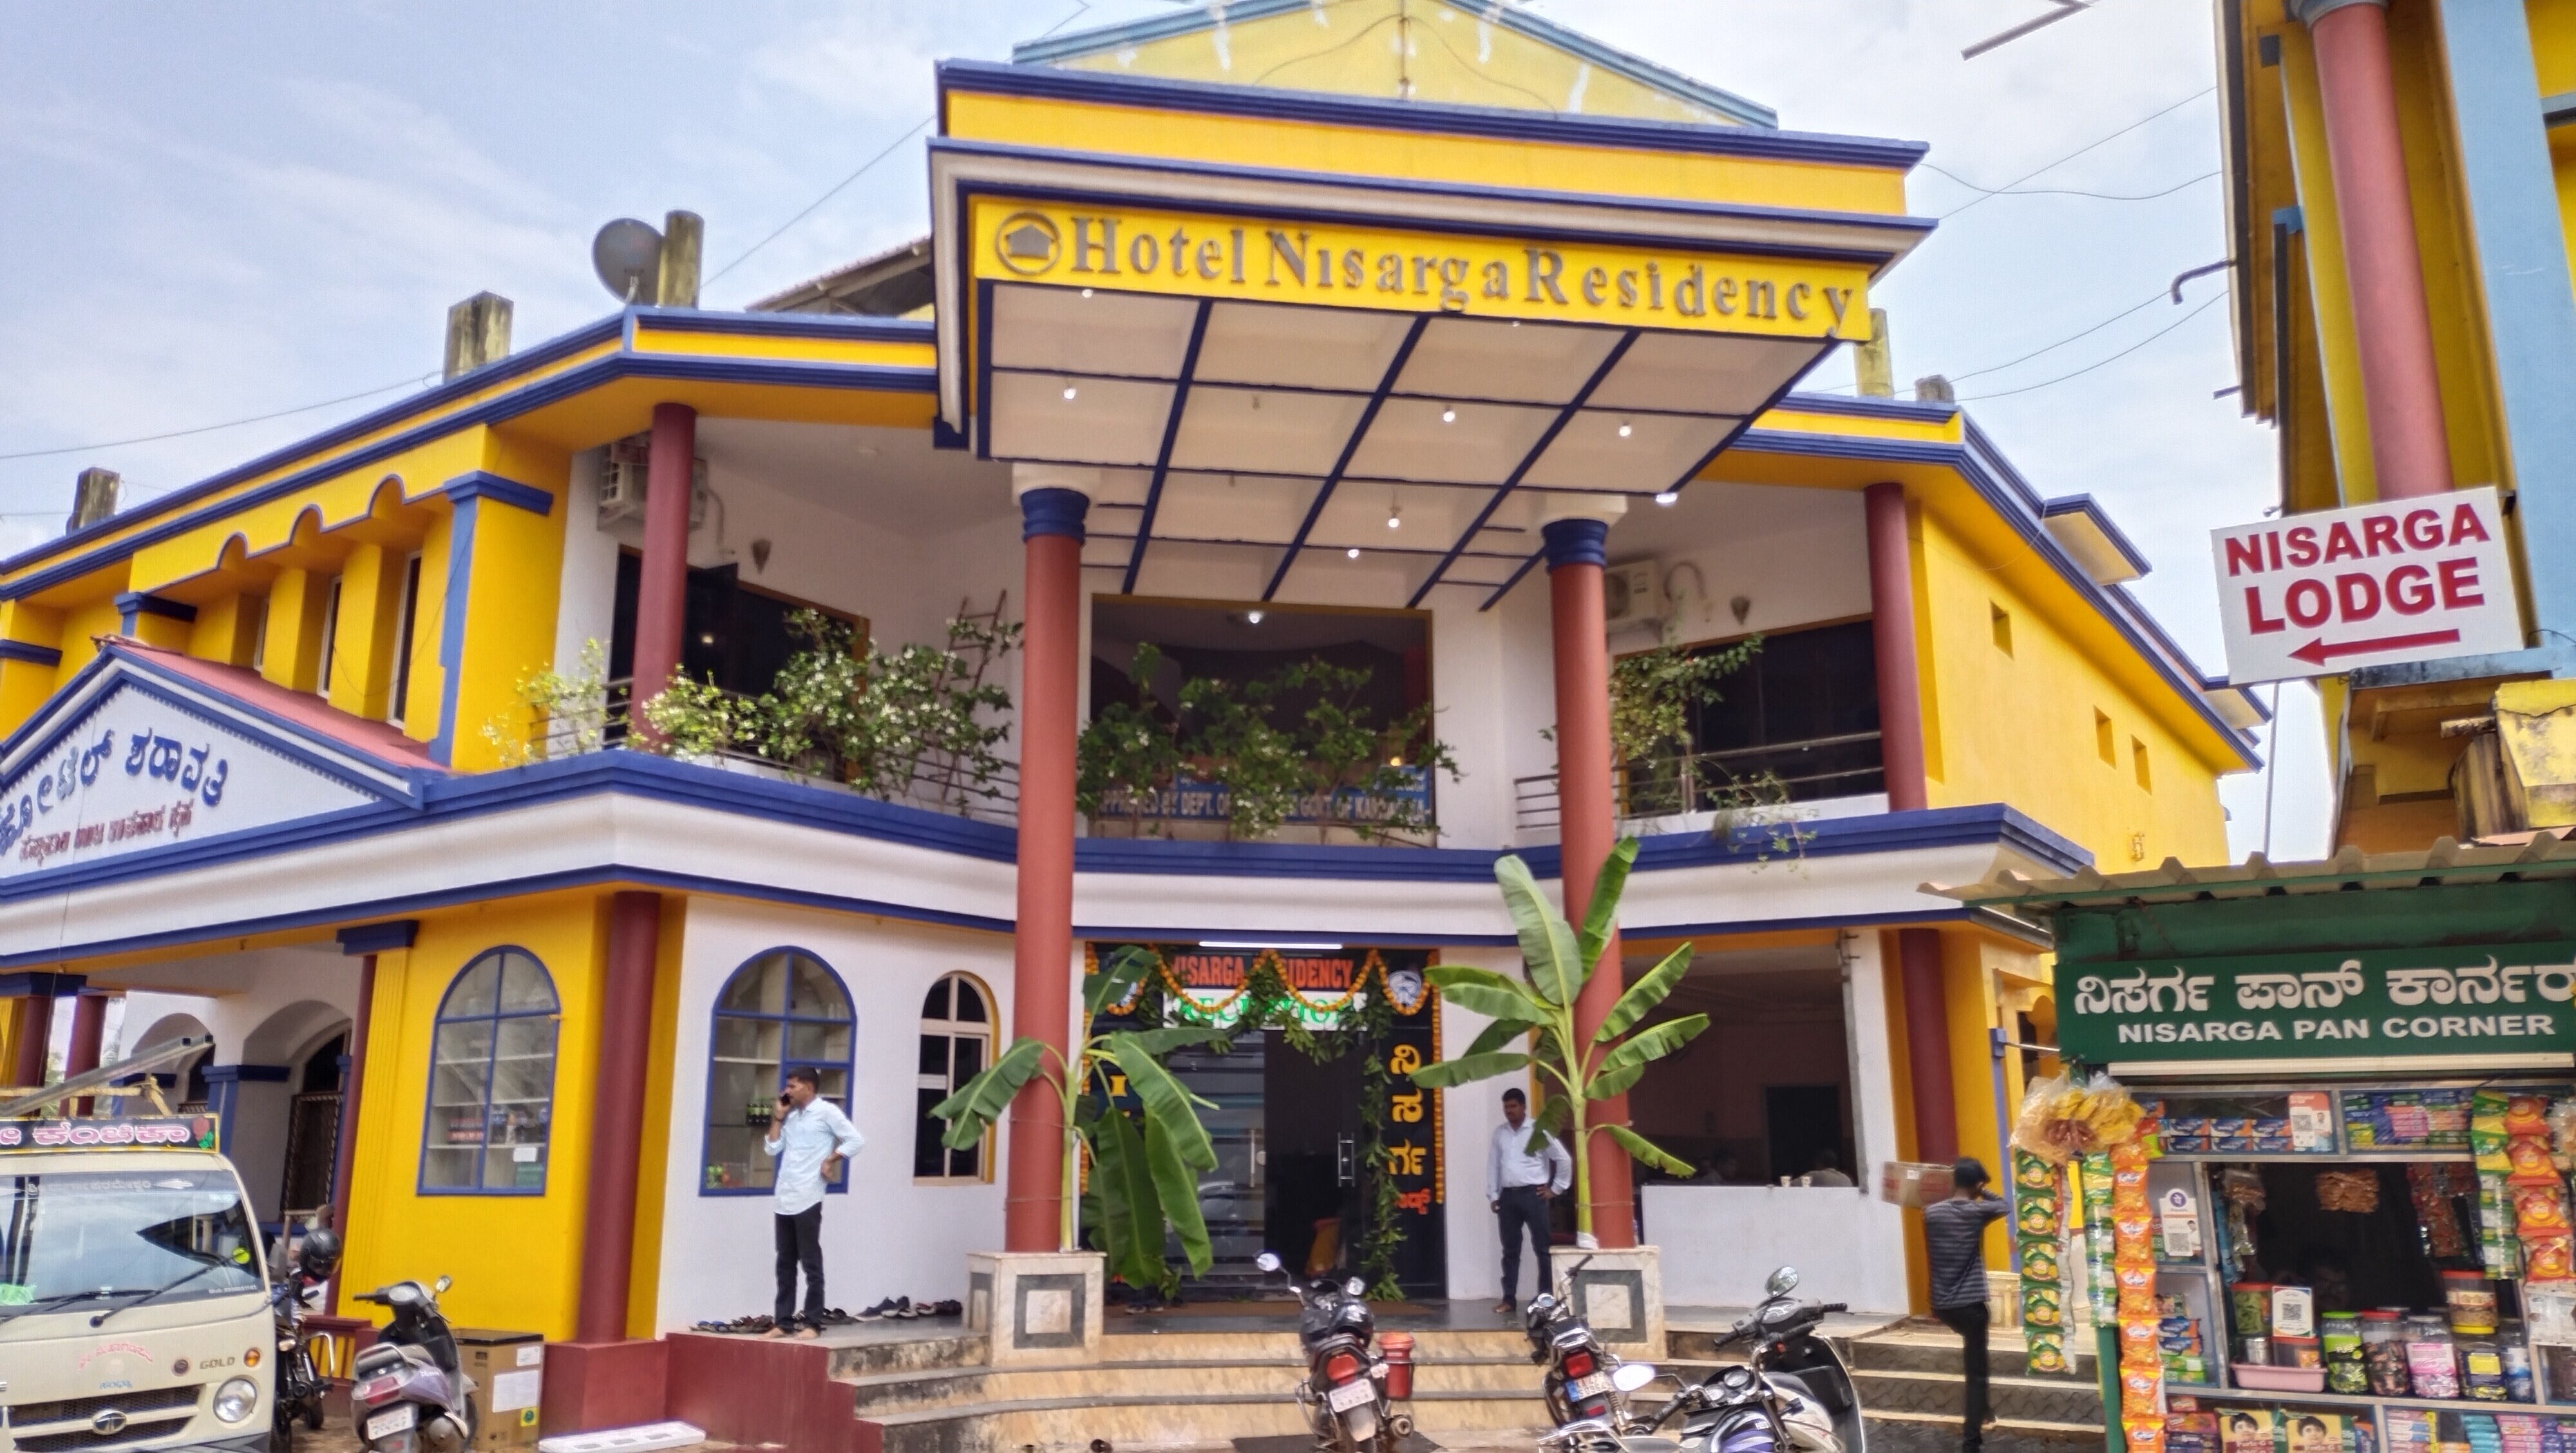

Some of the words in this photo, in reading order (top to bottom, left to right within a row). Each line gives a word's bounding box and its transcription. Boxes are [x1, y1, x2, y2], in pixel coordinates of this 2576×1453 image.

[1070, 215, 1246, 285] Hotel
[1264, 230, 1509, 312] Nisarga
[1522, 246, 1853, 340] Residency
[2225, 503, 2490, 578] NISARGA
[2244, 556, 2485, 635] LODGE
[2073, 965, 2215, 1015] ನಿಸರ್ಗ
[2234, 958, 2365, 1010] ಪಾನ್
[2118, 1021, 2282, 1044] NISARGA
[2293, 1018, 2371, 1041] PAN
[2382, 1014, 2556, 1038] CORNER
[199, 1356, 236, 1369] GOLD
